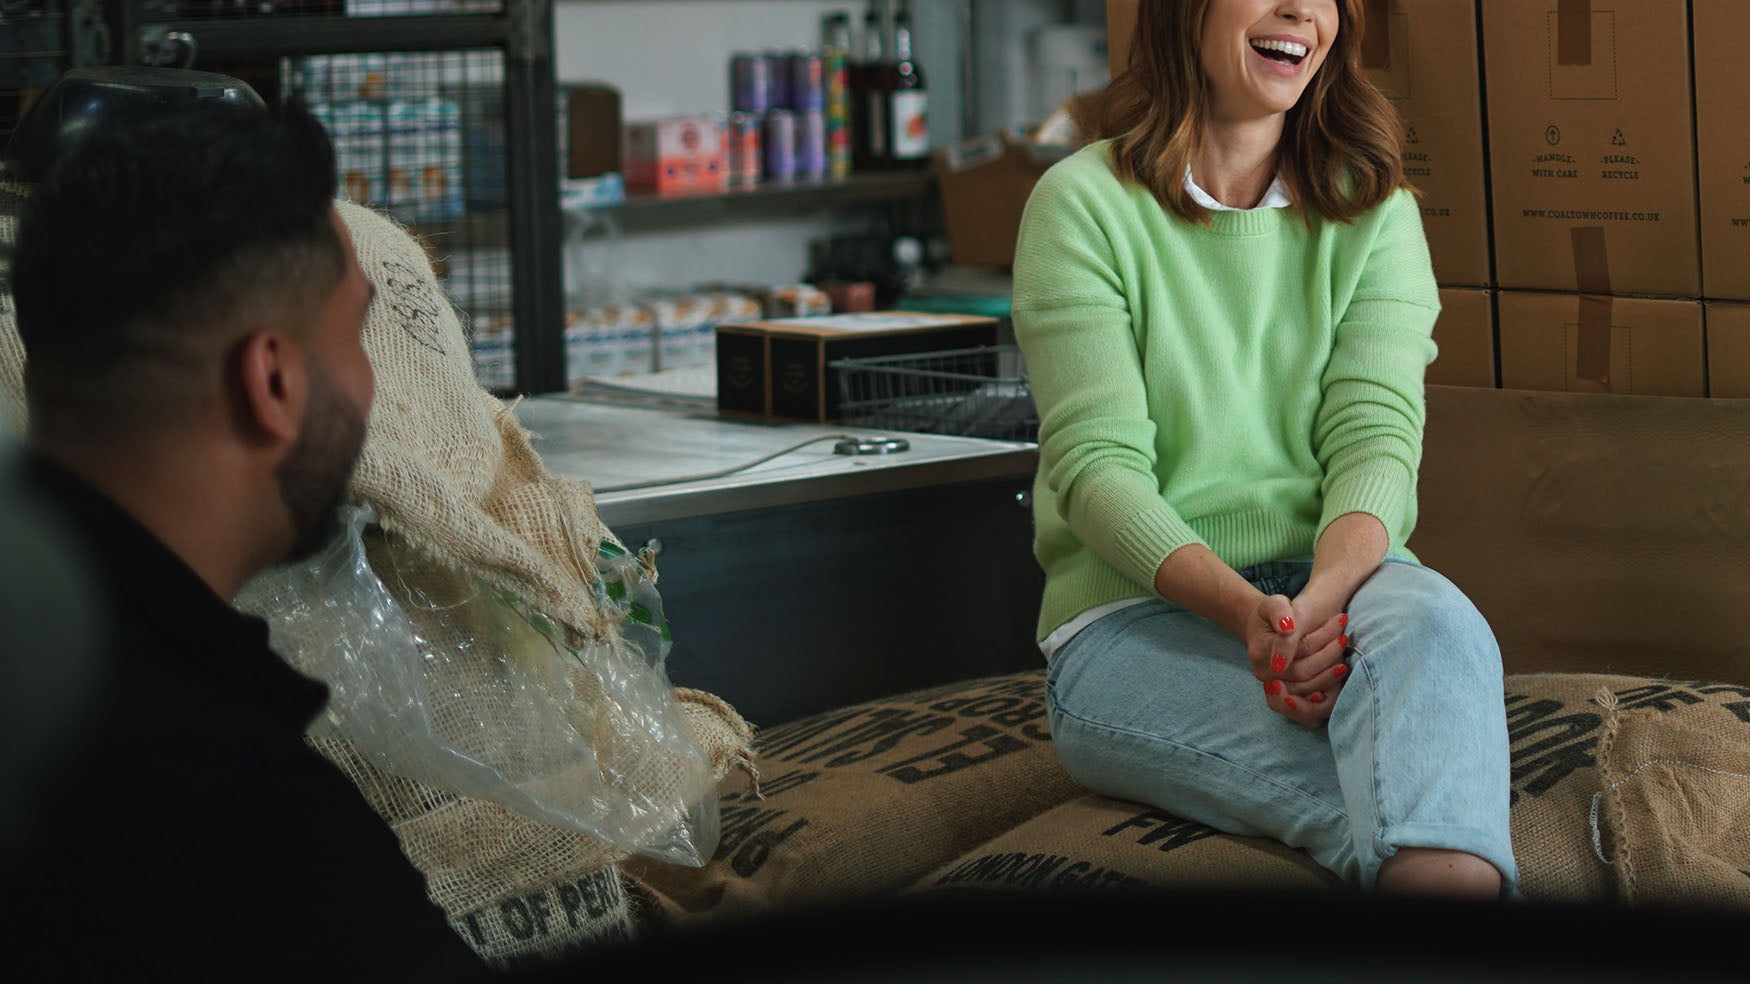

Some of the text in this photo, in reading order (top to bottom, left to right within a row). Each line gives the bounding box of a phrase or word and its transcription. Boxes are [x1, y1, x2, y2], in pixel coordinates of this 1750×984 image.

[1532, 169, 1578, 179] WITH CARE
[1602, 170, 1639, 180] RECYCLE
[1522, 208, 1660, 222] WWW.COALTOWNCOFFEE.CO.UK
